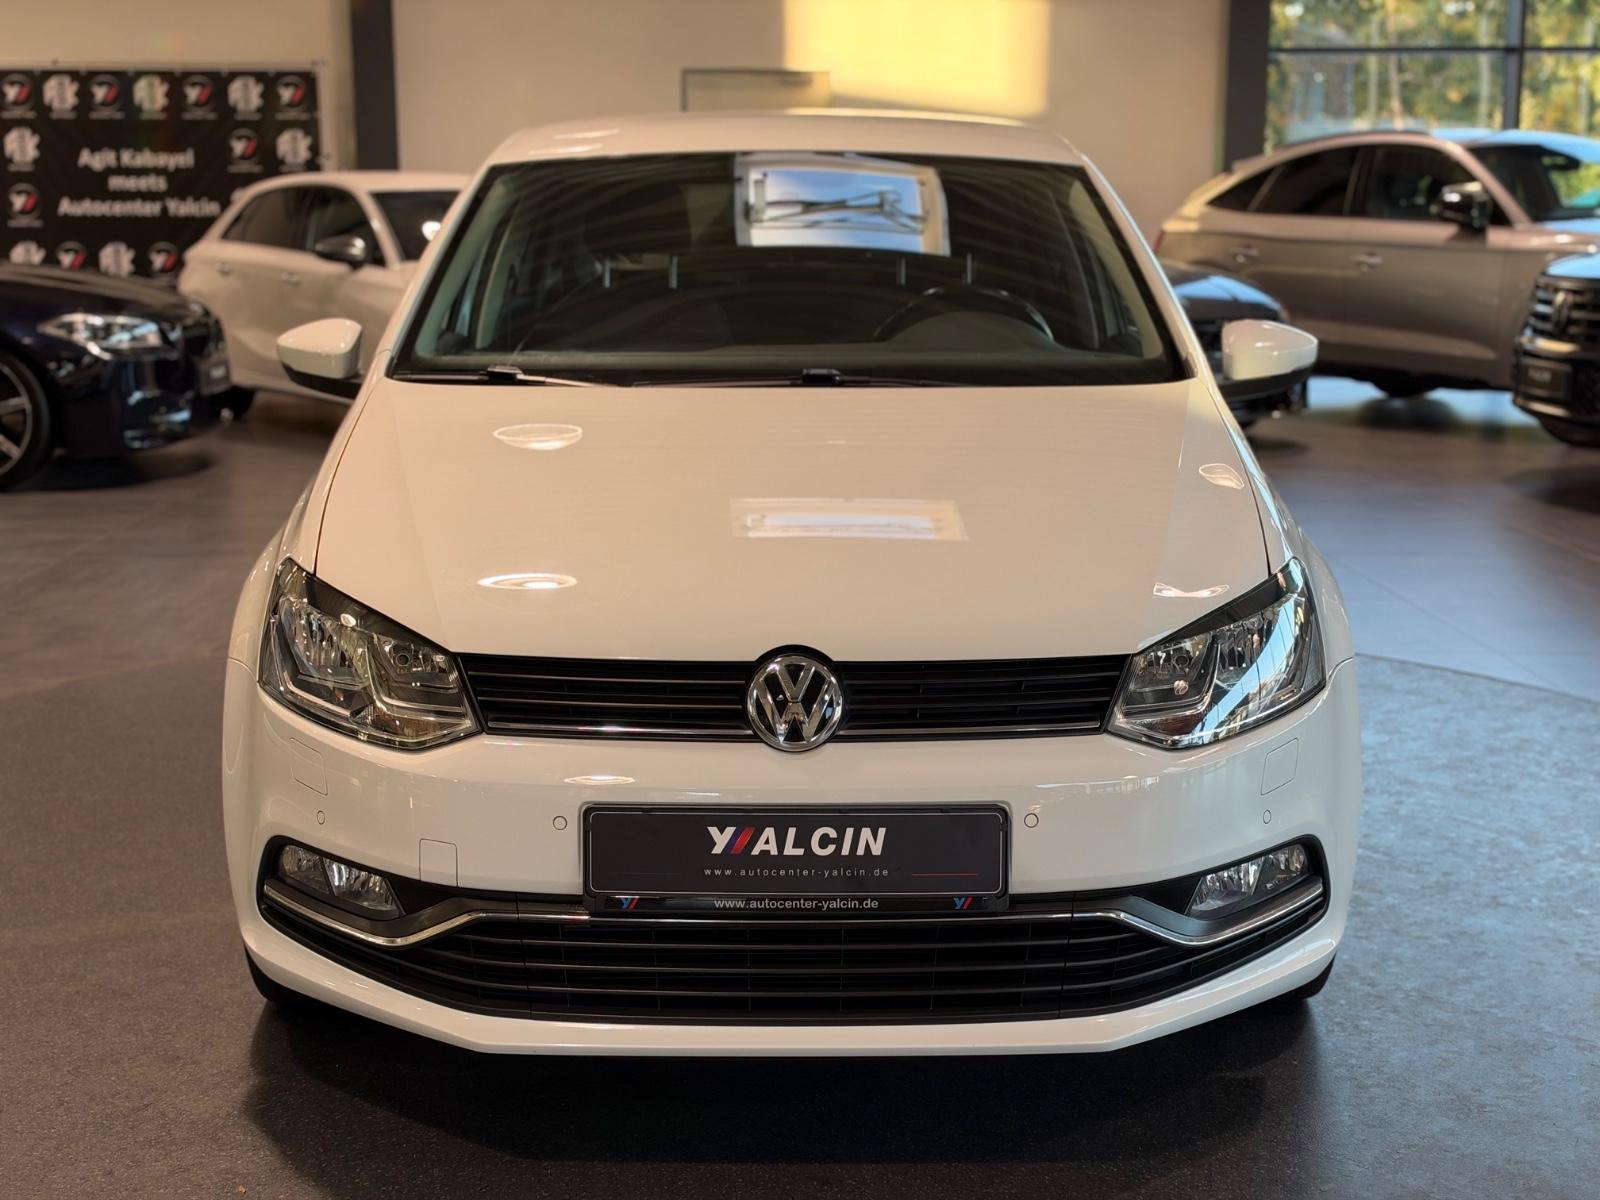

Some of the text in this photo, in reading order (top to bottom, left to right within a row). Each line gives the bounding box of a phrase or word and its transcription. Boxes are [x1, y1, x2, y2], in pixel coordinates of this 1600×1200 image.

[108, 174, 168, 192] meets
[57, 197, 162, 217] Autocenter
[703, 868, 889, 879] www.autocenter-yalcin.de
[714, 898, 880, 911] www.autocenter-yalcin.de
